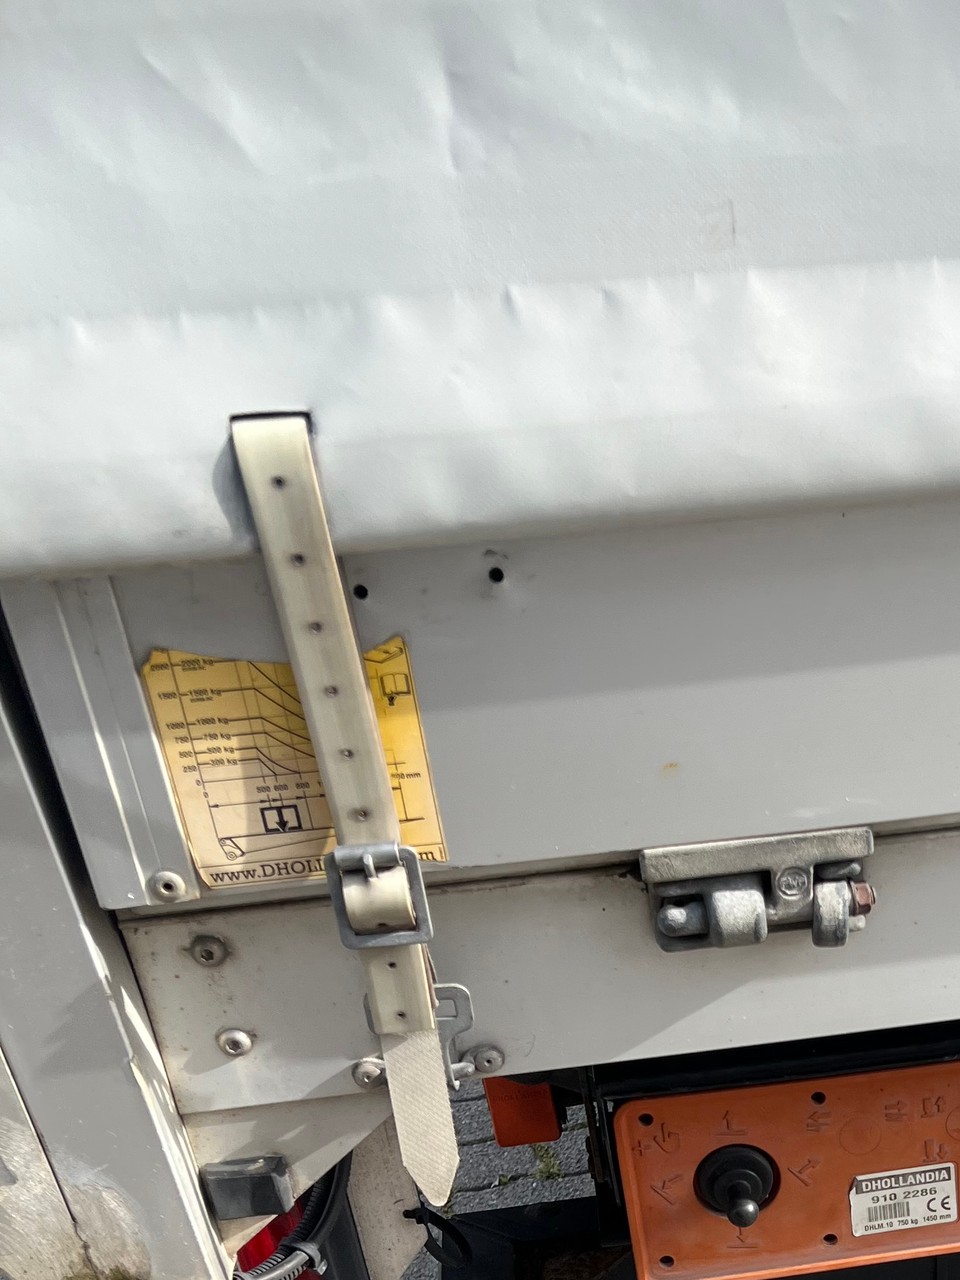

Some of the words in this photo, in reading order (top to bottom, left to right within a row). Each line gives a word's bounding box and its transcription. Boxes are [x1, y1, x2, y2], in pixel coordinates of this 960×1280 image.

[217, 717, 229, 725] kg
[220, 732, 232, 740] kg
[223, 746, 235, 754] kg
[226, 758, 238, 766] kg
[862, 1169, 949, 1192] DHOLLANDIA
[871, 1192, 898, 1204] 910
[903, 1187, 938, 1200] 2286
[898, 1219, 908, 1227] 750
[923, 1214, 938, 1223] 1450
